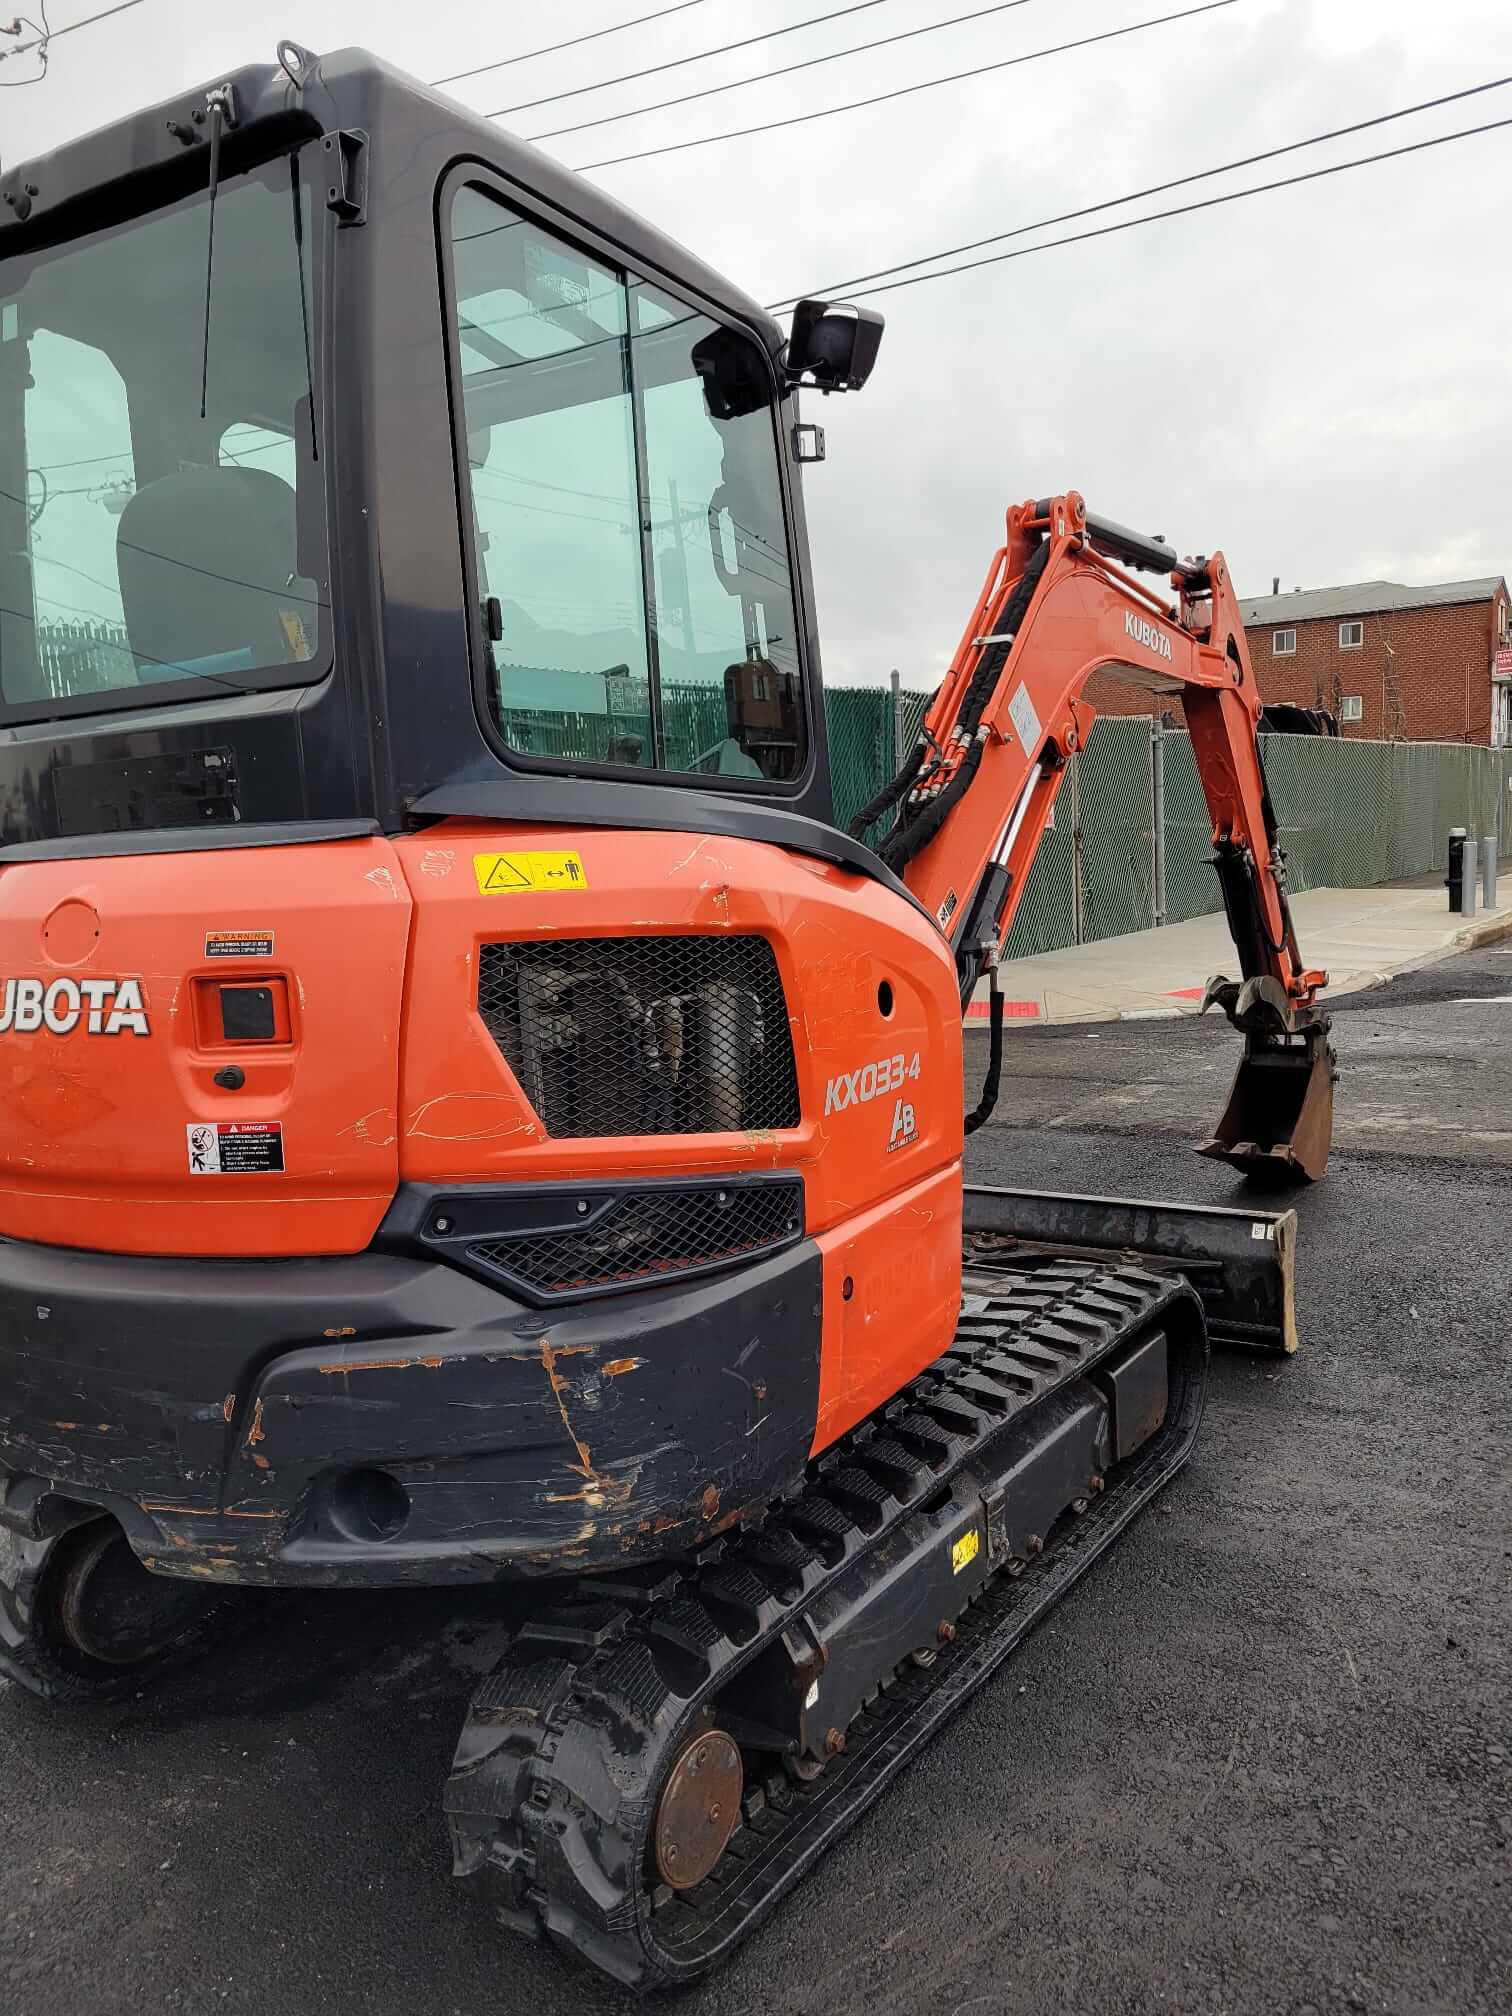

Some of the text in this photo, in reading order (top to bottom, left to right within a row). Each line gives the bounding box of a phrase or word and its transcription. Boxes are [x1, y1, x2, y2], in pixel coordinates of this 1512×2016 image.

[1125, 609, 1172, 661] KUBOTA
[824, 1051, 920, 1117] KX033-4
[241, 1124, 268, 1132] DANGER
